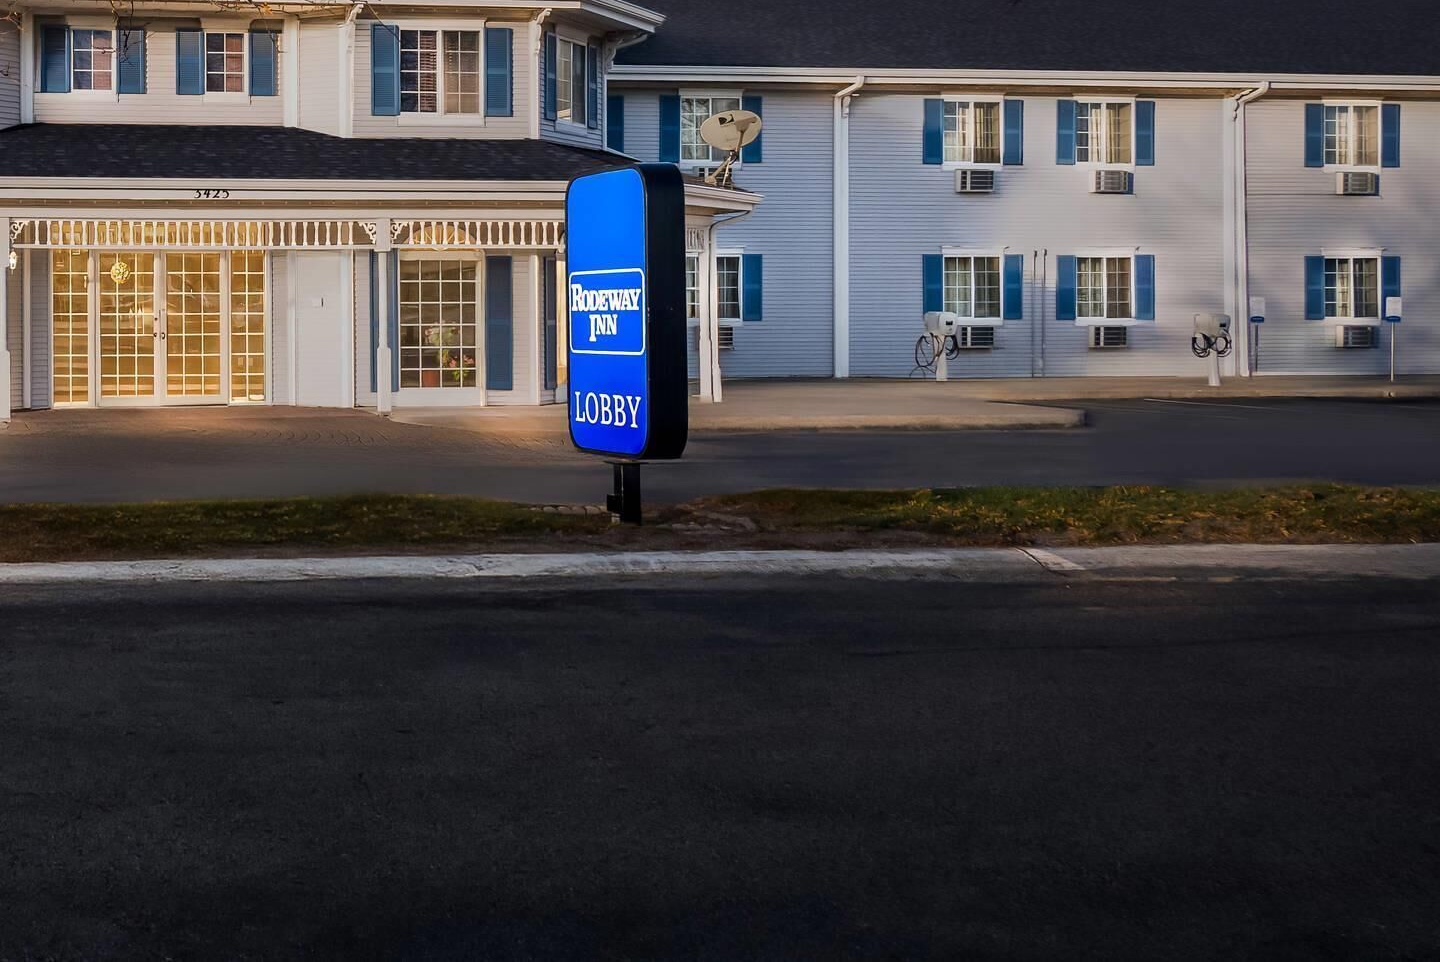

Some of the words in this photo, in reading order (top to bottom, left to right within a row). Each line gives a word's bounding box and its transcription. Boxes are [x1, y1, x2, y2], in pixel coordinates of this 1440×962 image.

[571, 283, 641, 311] RODEWAY
[589, 314, 618, 342] INN
[574, 391, 642, 428] LOBBY
